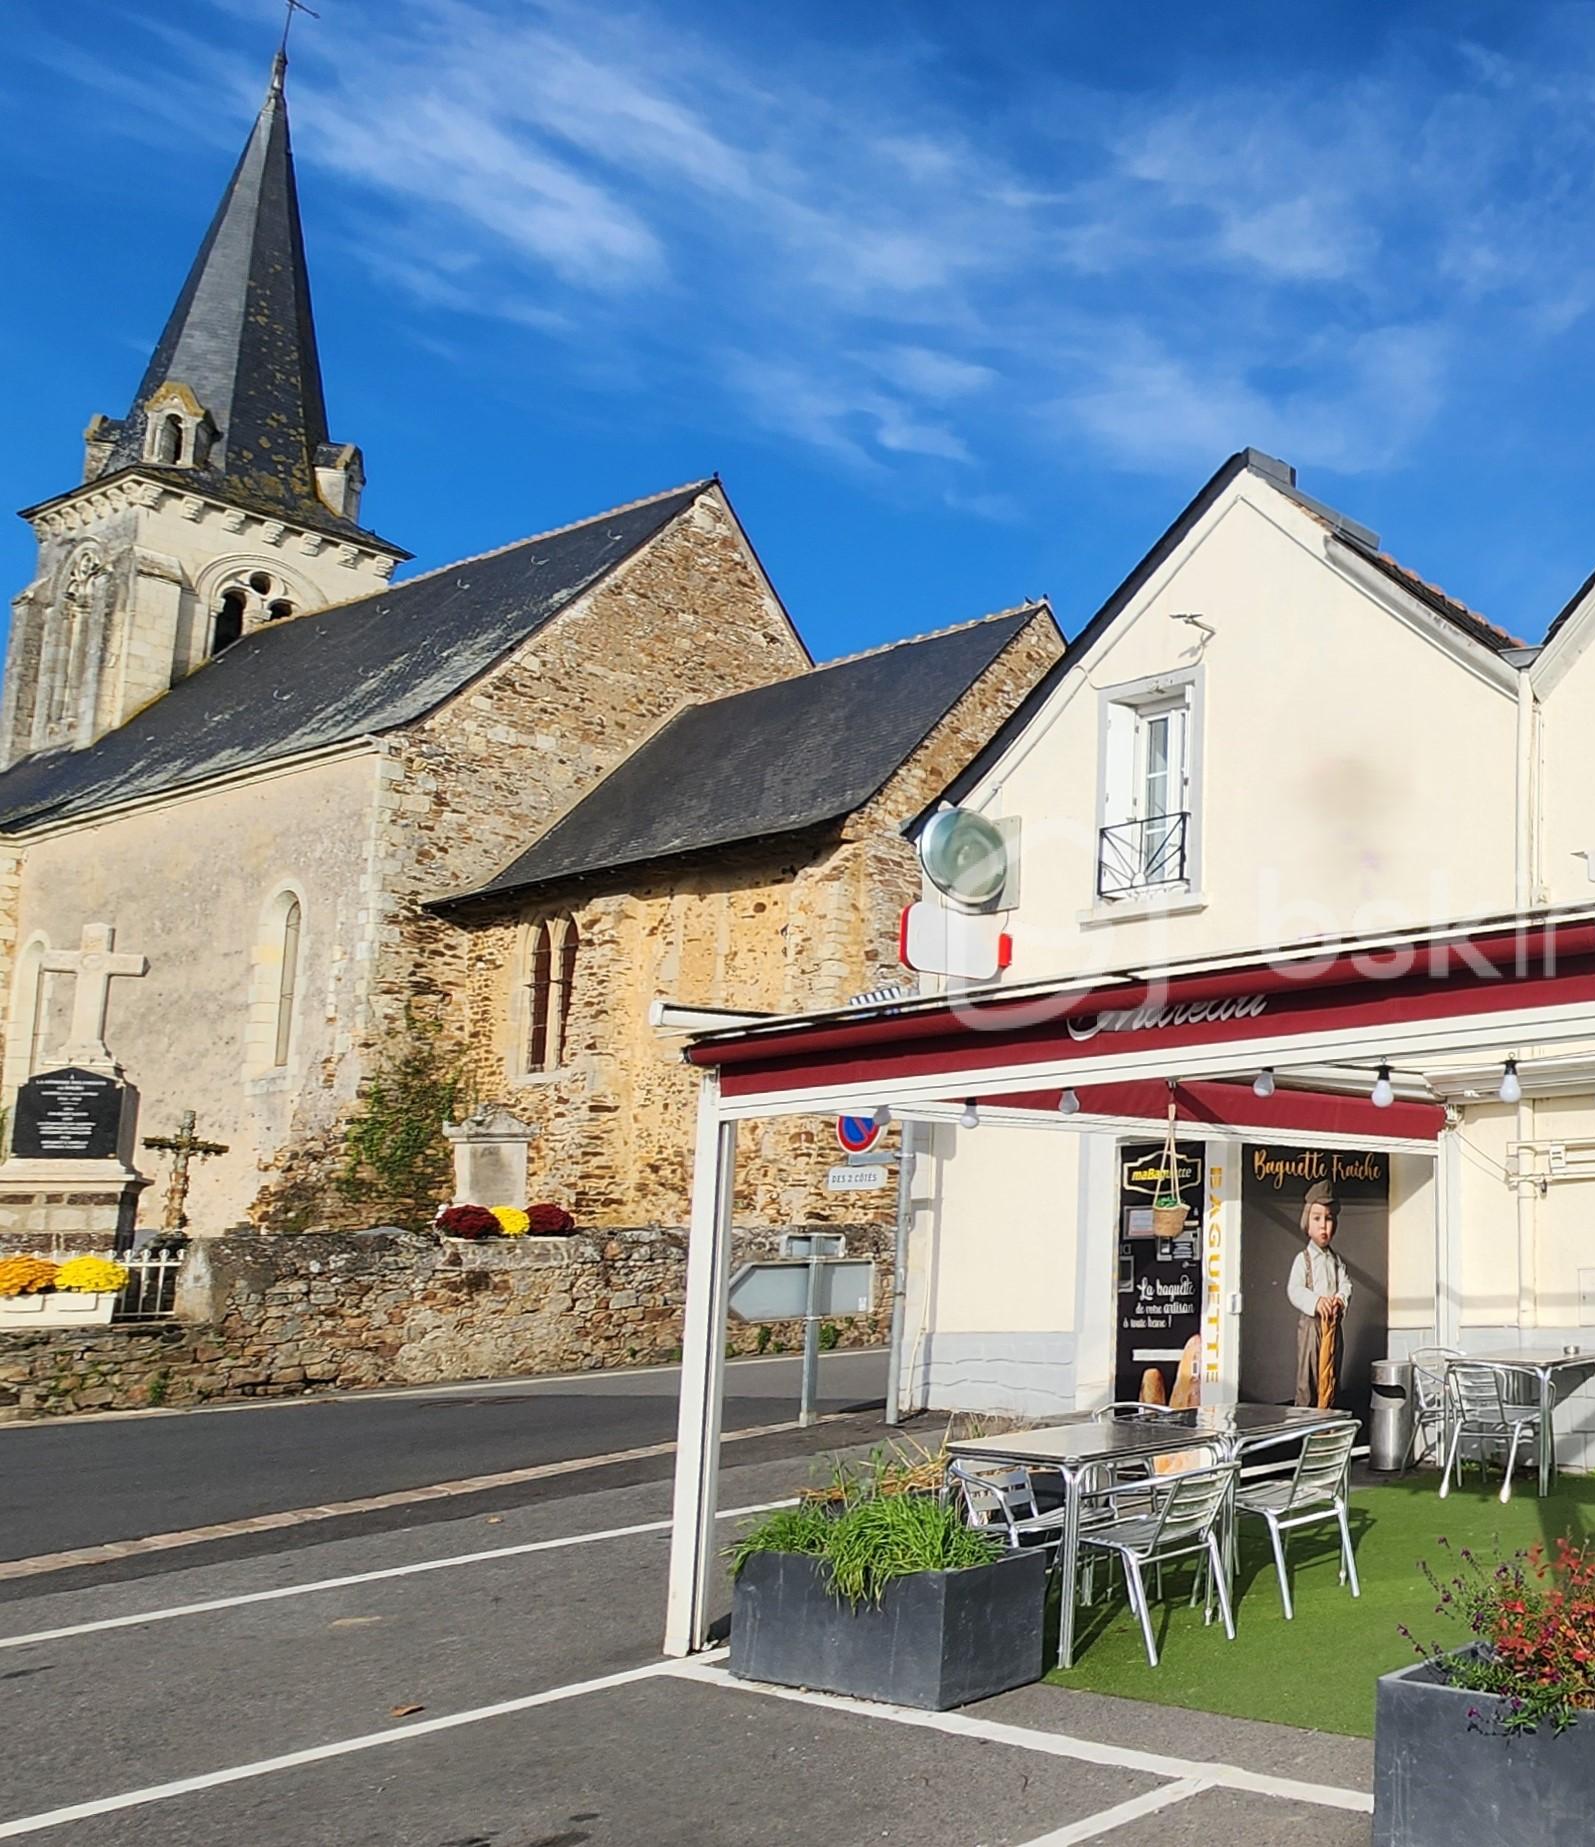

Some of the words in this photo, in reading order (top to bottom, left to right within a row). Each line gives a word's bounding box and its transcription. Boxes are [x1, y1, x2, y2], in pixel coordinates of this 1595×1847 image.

[832, 1175, 846, 1183] DES
[848, 1175, 853, 1183] 2
[1254, 1149, 1327, 1189] Baguette
[1136, 1277, 1155, 1300] La
[1156, 1274, 1195, 1302] baguette
[1207, 1166, 1223, 1384] BAGUETTE
[1163, 1302, 1194, 1314] artisan
